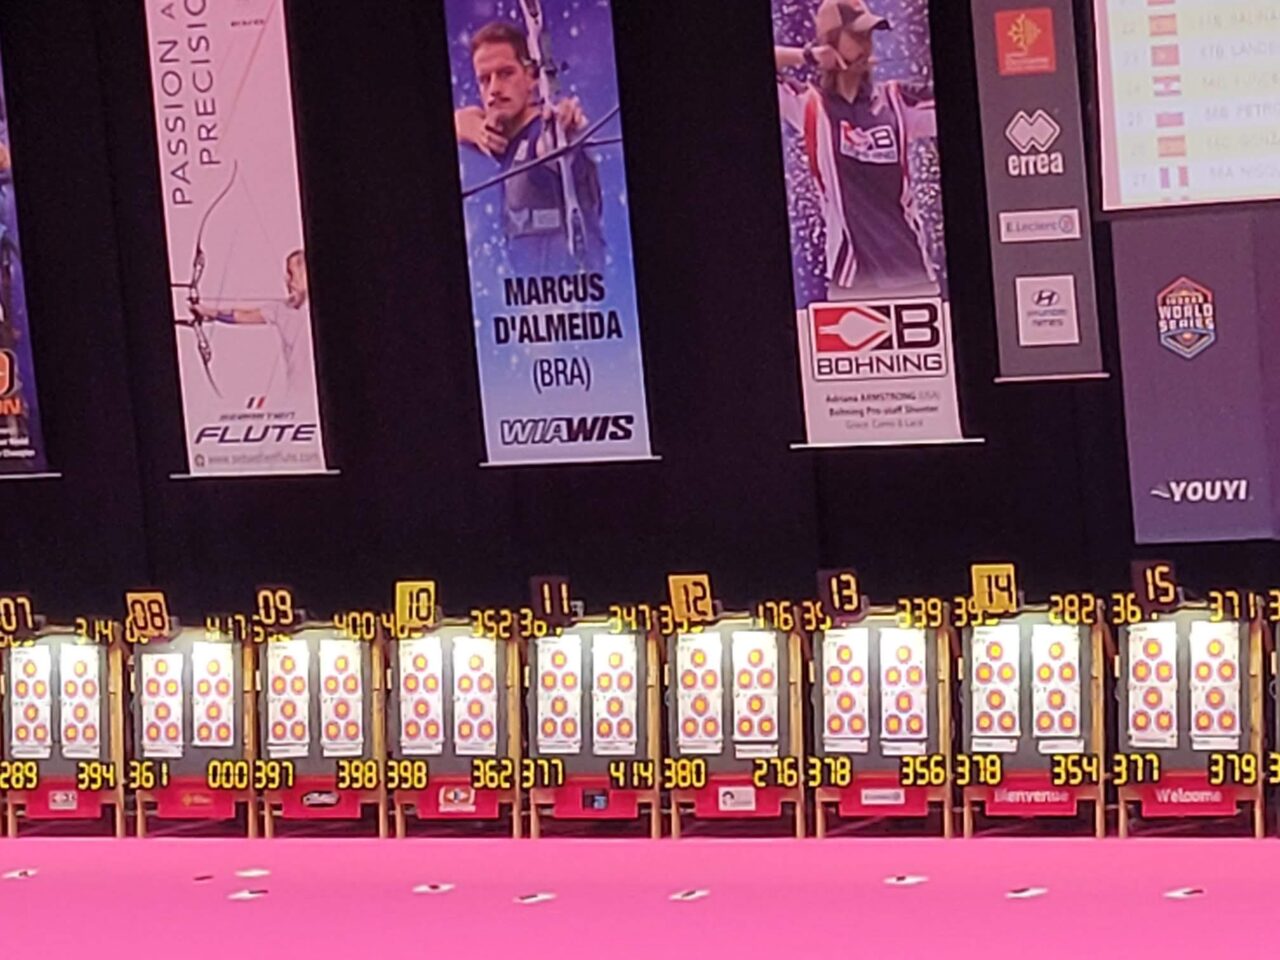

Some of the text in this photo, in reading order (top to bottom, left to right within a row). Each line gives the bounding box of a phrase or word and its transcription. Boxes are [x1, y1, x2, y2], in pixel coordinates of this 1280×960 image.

[157, 39, 194, 206] PASSION
[503, 272, 606, 307] MARCUS
[1158, 302, 1214, 320] WORLD
[493, 310, 624, 345] D'ALMEIDA
[533, 356, 592, 395] (BRA)
[816, 353, 943, 376] BOHNING
[194, 423, 318, 444] FLUTE
[500, 414, 635, 446] WIAWIS
[1169, 479, 1248, 502] YOUYI
[542, 583, 569, 614] 11
[683, 581, 708, 616] 12
[831, 573, 858, 611] 13
[981, 573, 1013, 605] 14
[1145, 565, 1175, 603] 15
[0, 597, 32, 632] 07
[131, 599, 166, 630] 08
[257, 589, 293, 625] 09
[408, 587, 431, 621] 10
[1209, 590, 1255, 622] 371
[471, 609, 512, 638] 352
[77, 761, 115, 790] 394
[128, 760, 169, 788] 361
[207, 760, 248, 788] 000
[254, 760, 294, 788] 397
[338, 760, 378, 788] 398
[387, 760, 427, 789] 398
[473, 759, 511, 789] 362
[522, 759, 563, 788] 377
[610, 760, 654, 788] 414
[664, 757, 706, 789] 380
[753, 757, 797, 788] 276
[808, 757, 851, 787] 378
[901, 756, 945, 786] 356
[956, 754, 1001, 785] 378
[1053, 754, 1099, 785] 354
[1113, 753, 1160, 785] 377
[1210, 753, 1257, 785] 379
[1155, 787, 1223, 803] Welcome
